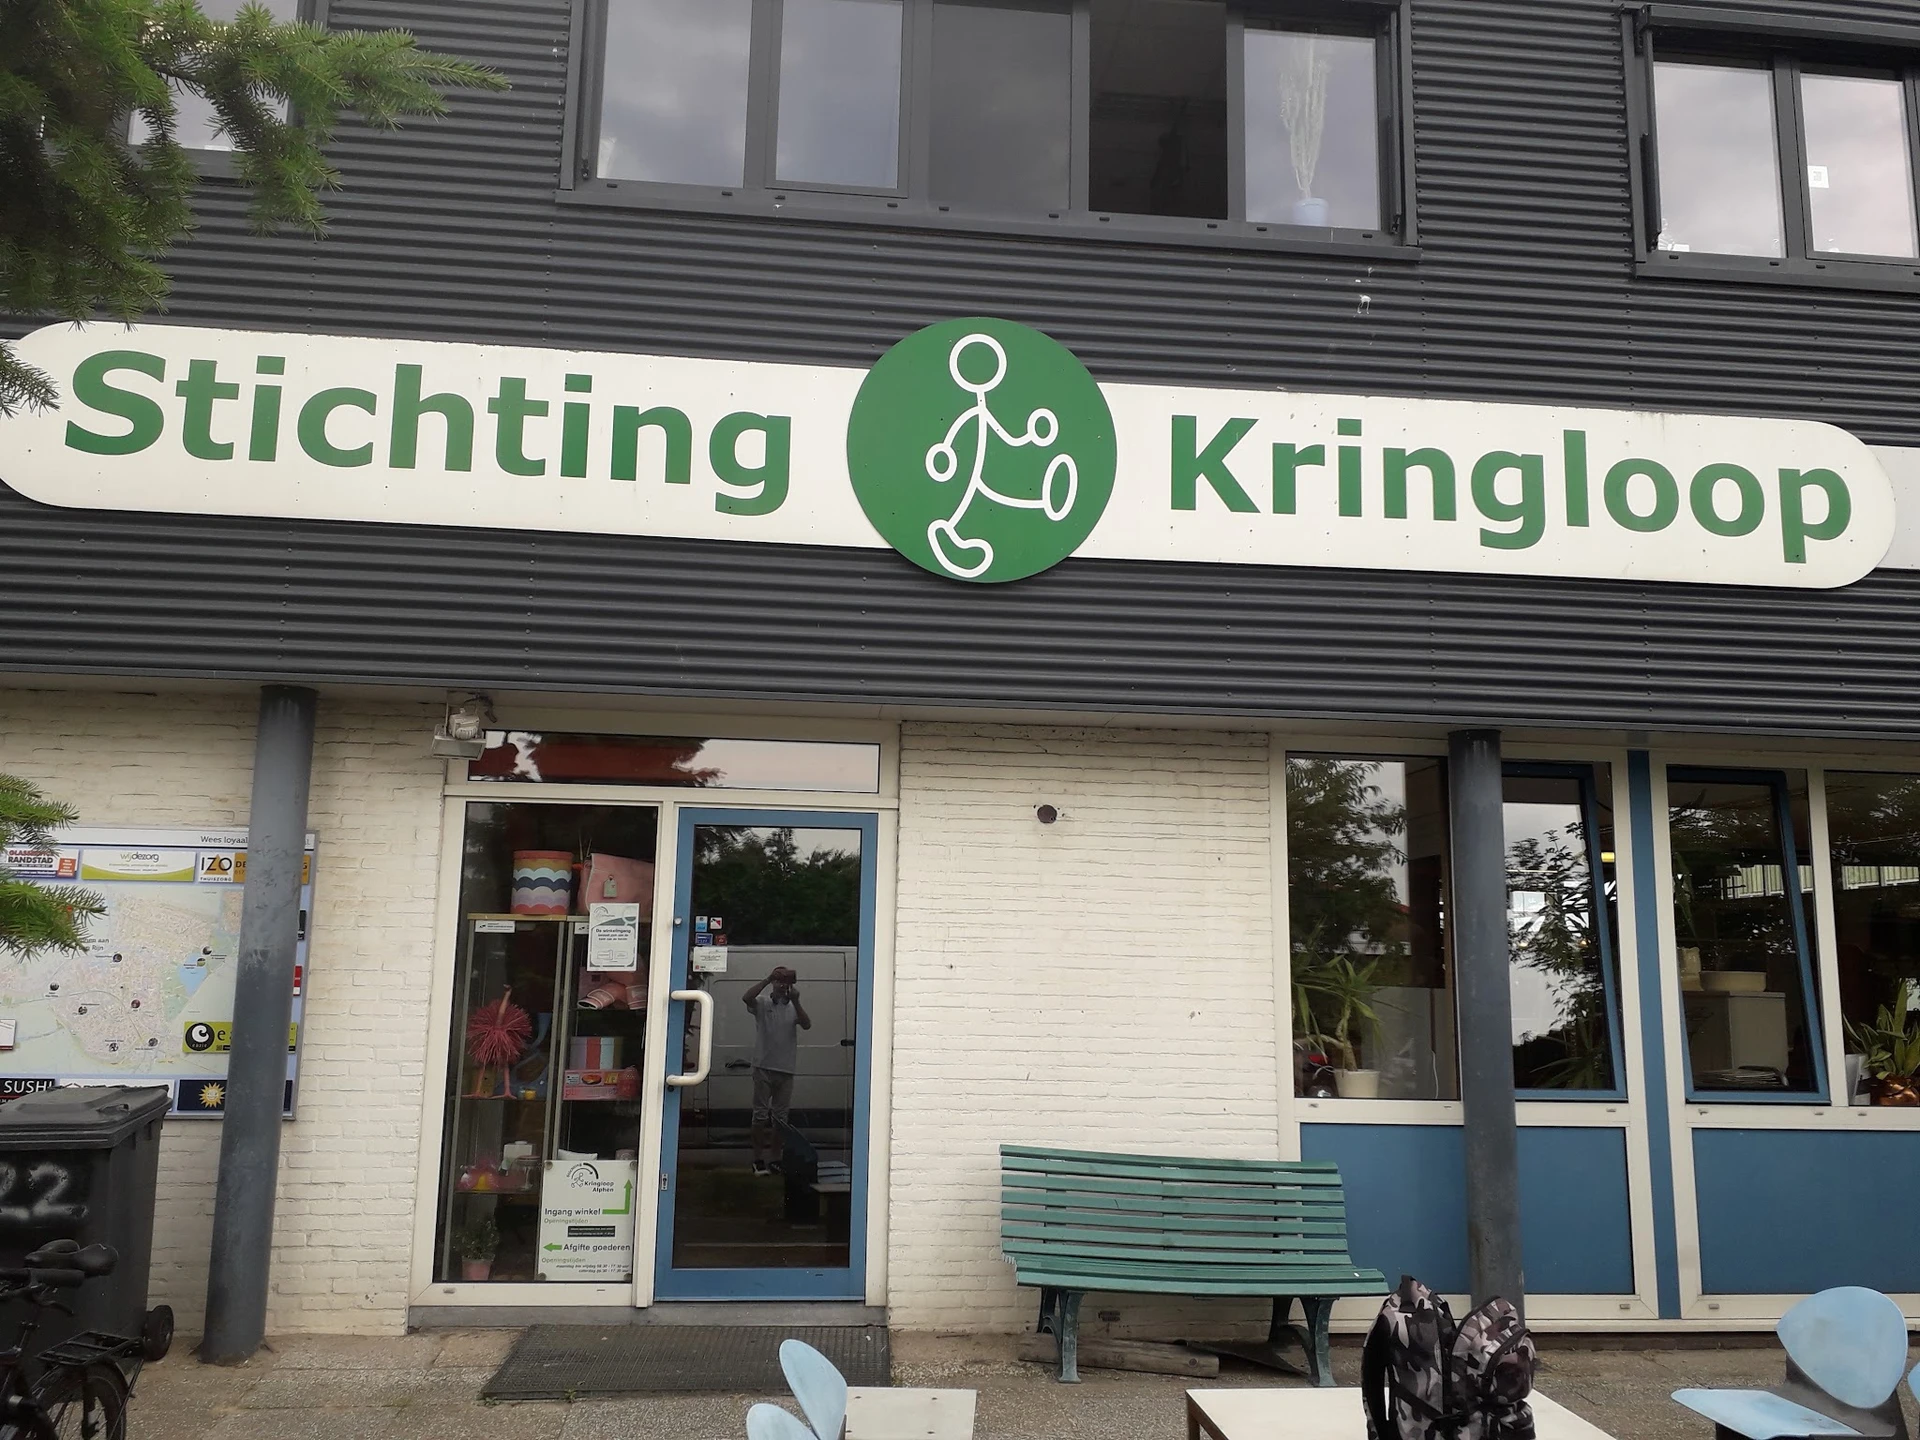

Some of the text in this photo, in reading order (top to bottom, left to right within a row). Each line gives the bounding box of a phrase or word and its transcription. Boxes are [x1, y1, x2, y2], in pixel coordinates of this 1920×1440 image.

[64, 349, 1852, 564] Stichting Kringloop
[200, 836, 248, 846] Wees loyaal
[8, 856, 54, 864] RANDSTAD
[201, 856, 233, 871] IZO
[544, 1208, 601, 1217] Ingang winkel
[563, 1243, 631, 1253] Afgifte goederen
